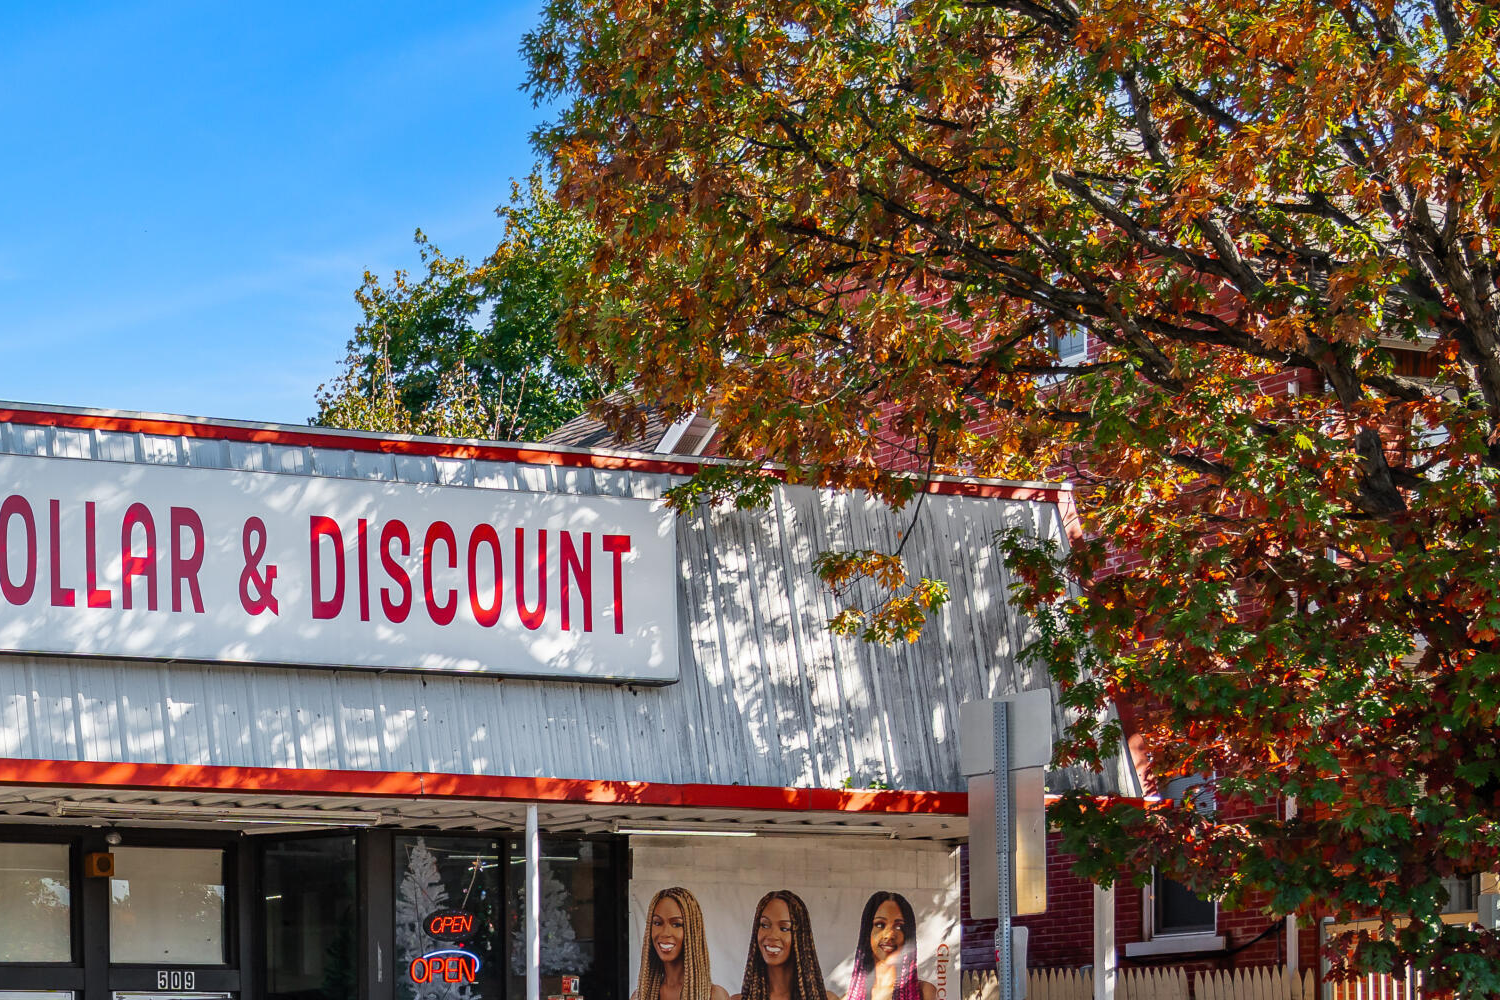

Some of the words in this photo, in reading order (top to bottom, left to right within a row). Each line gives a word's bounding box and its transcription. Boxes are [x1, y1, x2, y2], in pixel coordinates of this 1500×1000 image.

[238, 515, 280, 617] &
[309, 515, 632, 634] DISCOUNT
[430, 914, 473, 934] OPEN
[158, 971, 194, 989] 509
[410, 957, 476, 983] OPEN
